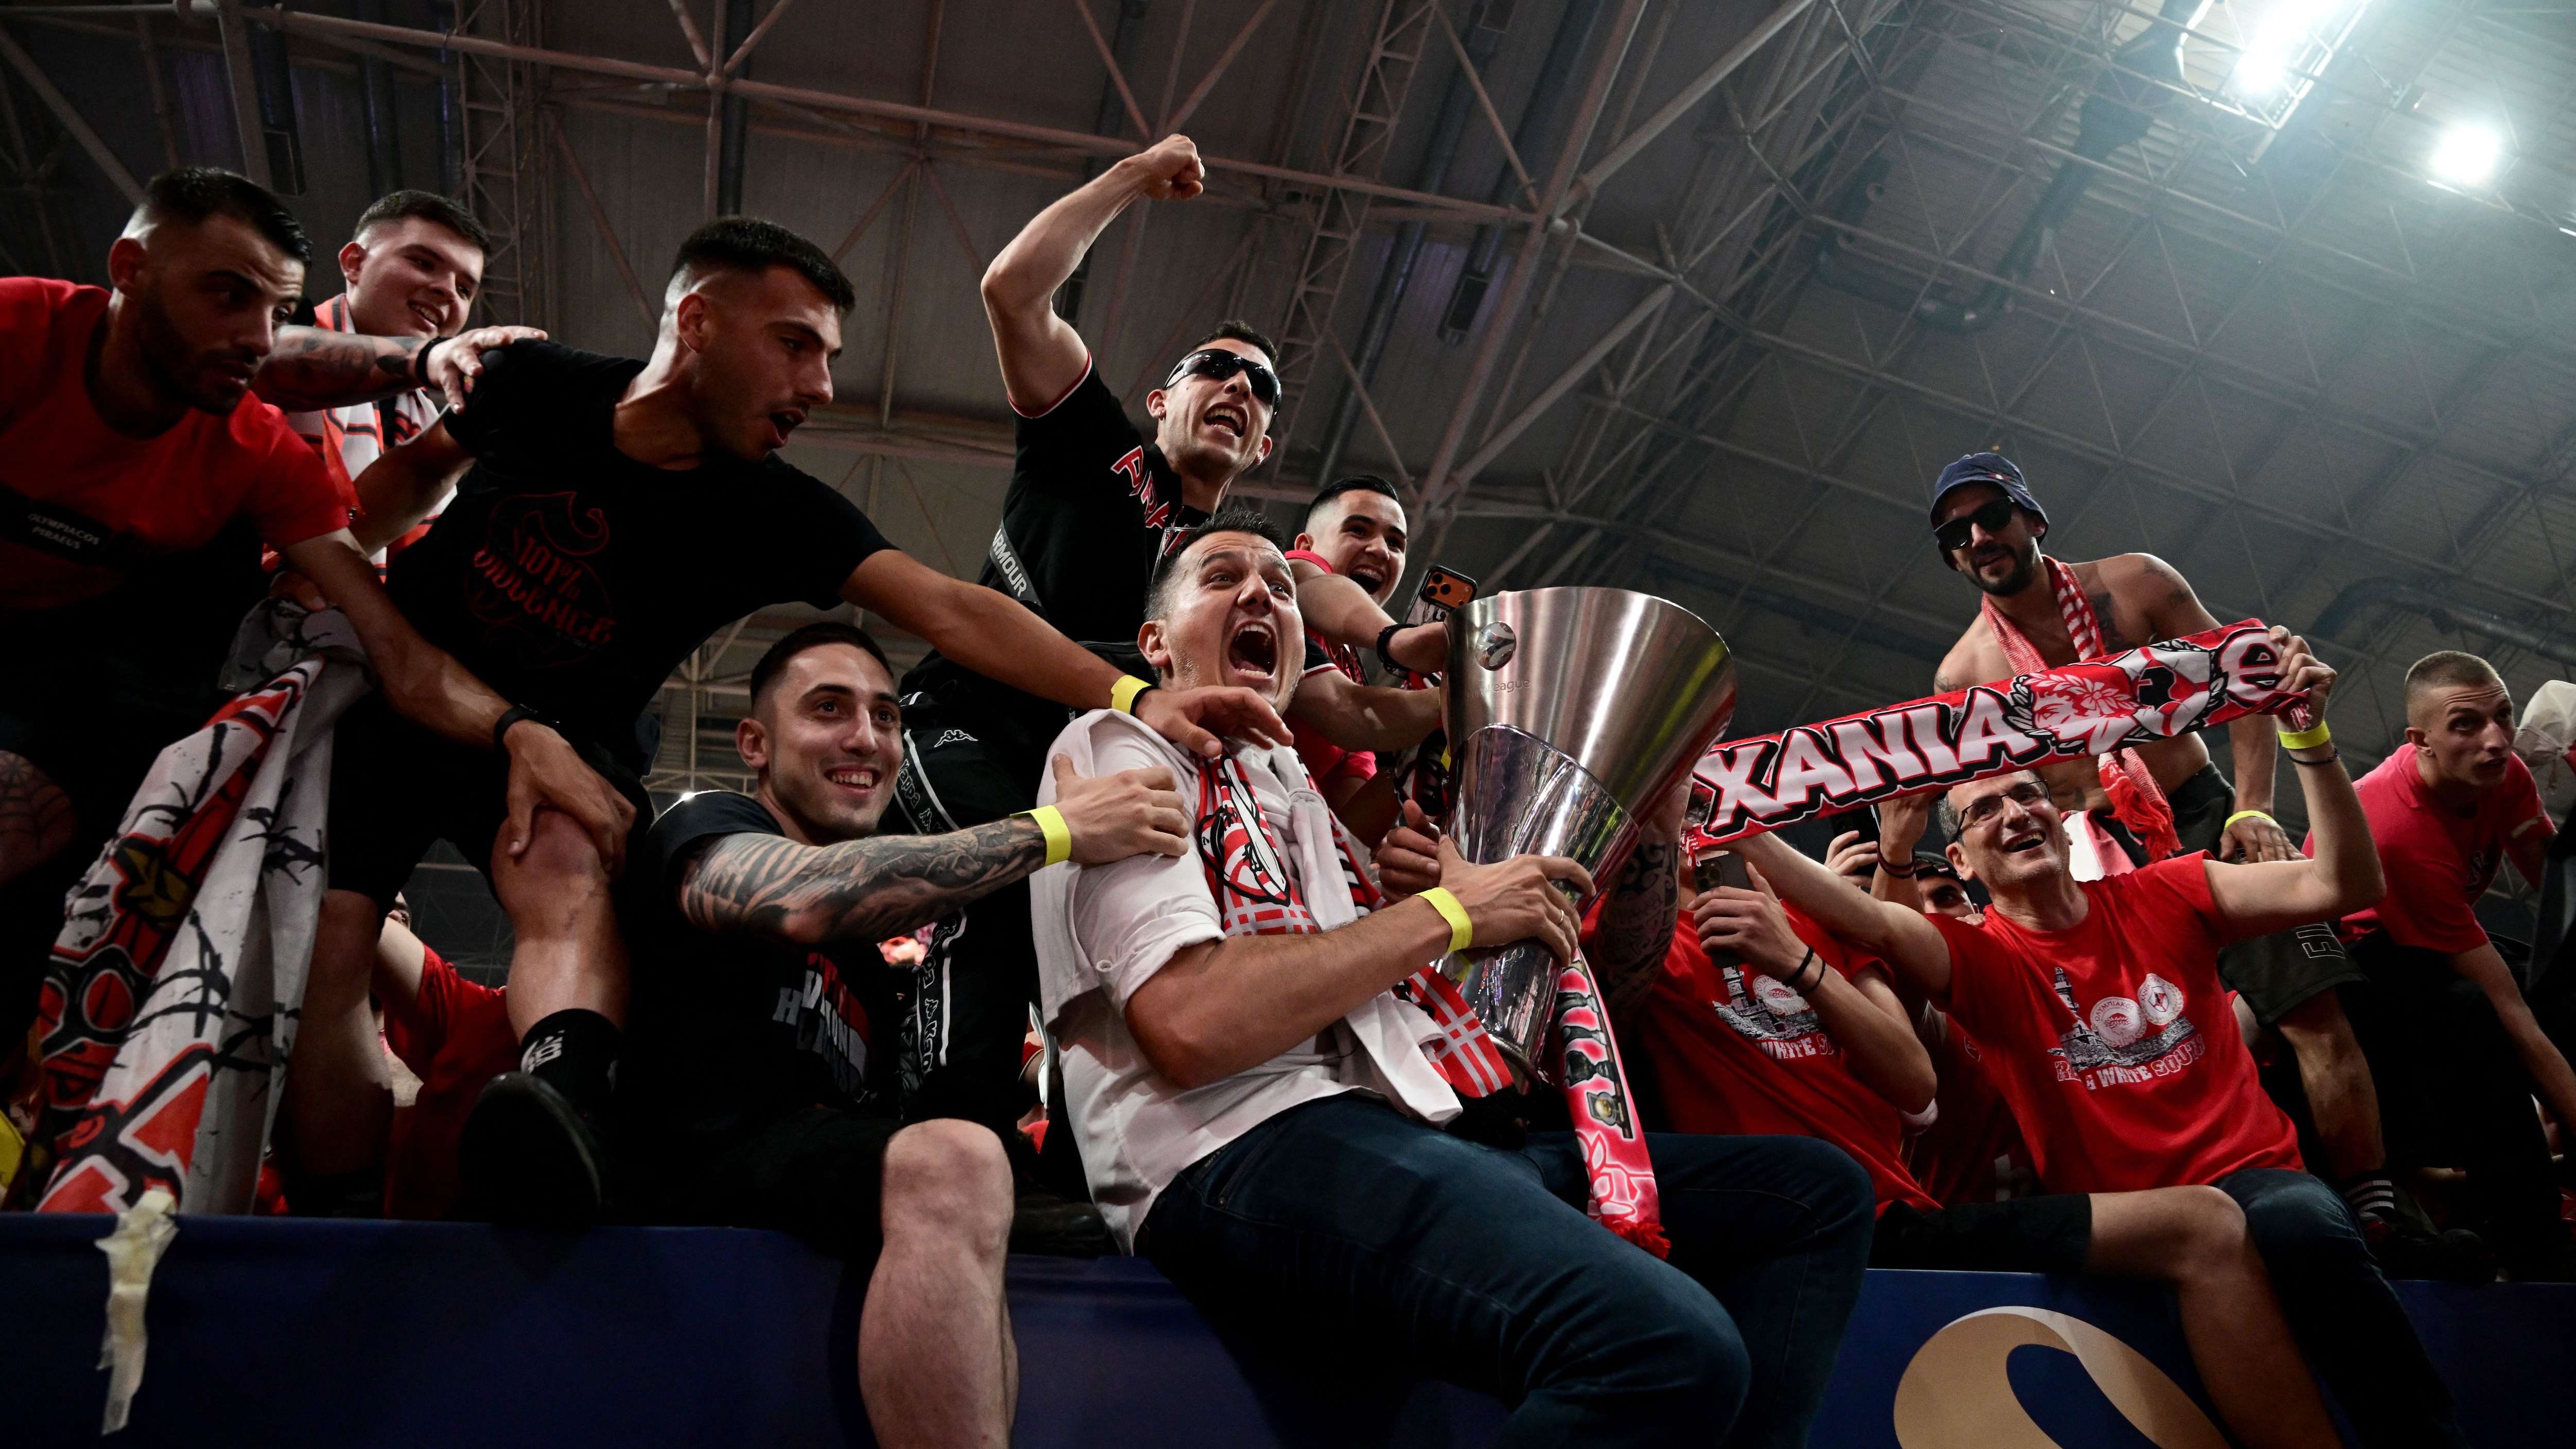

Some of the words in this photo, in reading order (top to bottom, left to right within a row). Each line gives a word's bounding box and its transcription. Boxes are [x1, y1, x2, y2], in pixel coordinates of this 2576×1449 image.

[27, 513, 101, 545] OLYMPIACOS
[32, 526, 81, 549] PIRAEUS
[2096, 1065, 2153, 1088] WHITE
